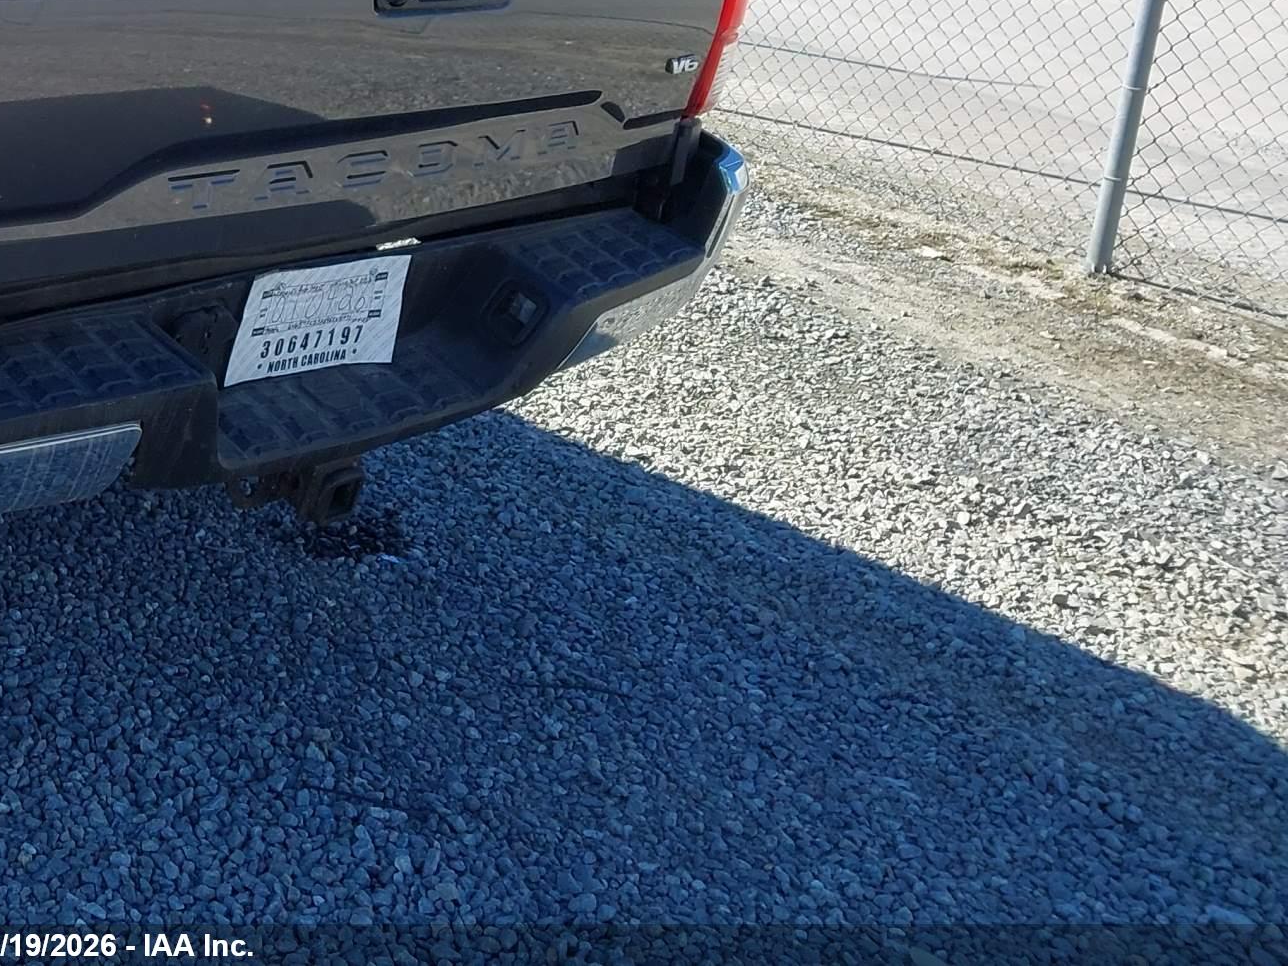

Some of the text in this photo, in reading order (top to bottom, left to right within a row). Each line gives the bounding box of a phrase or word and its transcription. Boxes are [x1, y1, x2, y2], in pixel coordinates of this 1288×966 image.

[670, 55, 699, 75] V6
[167, 120, 579, 210] TACOMA
[260, 325, 364, 359] 30647197
[267, 349, 347, 373] NORTH CAROLINA
